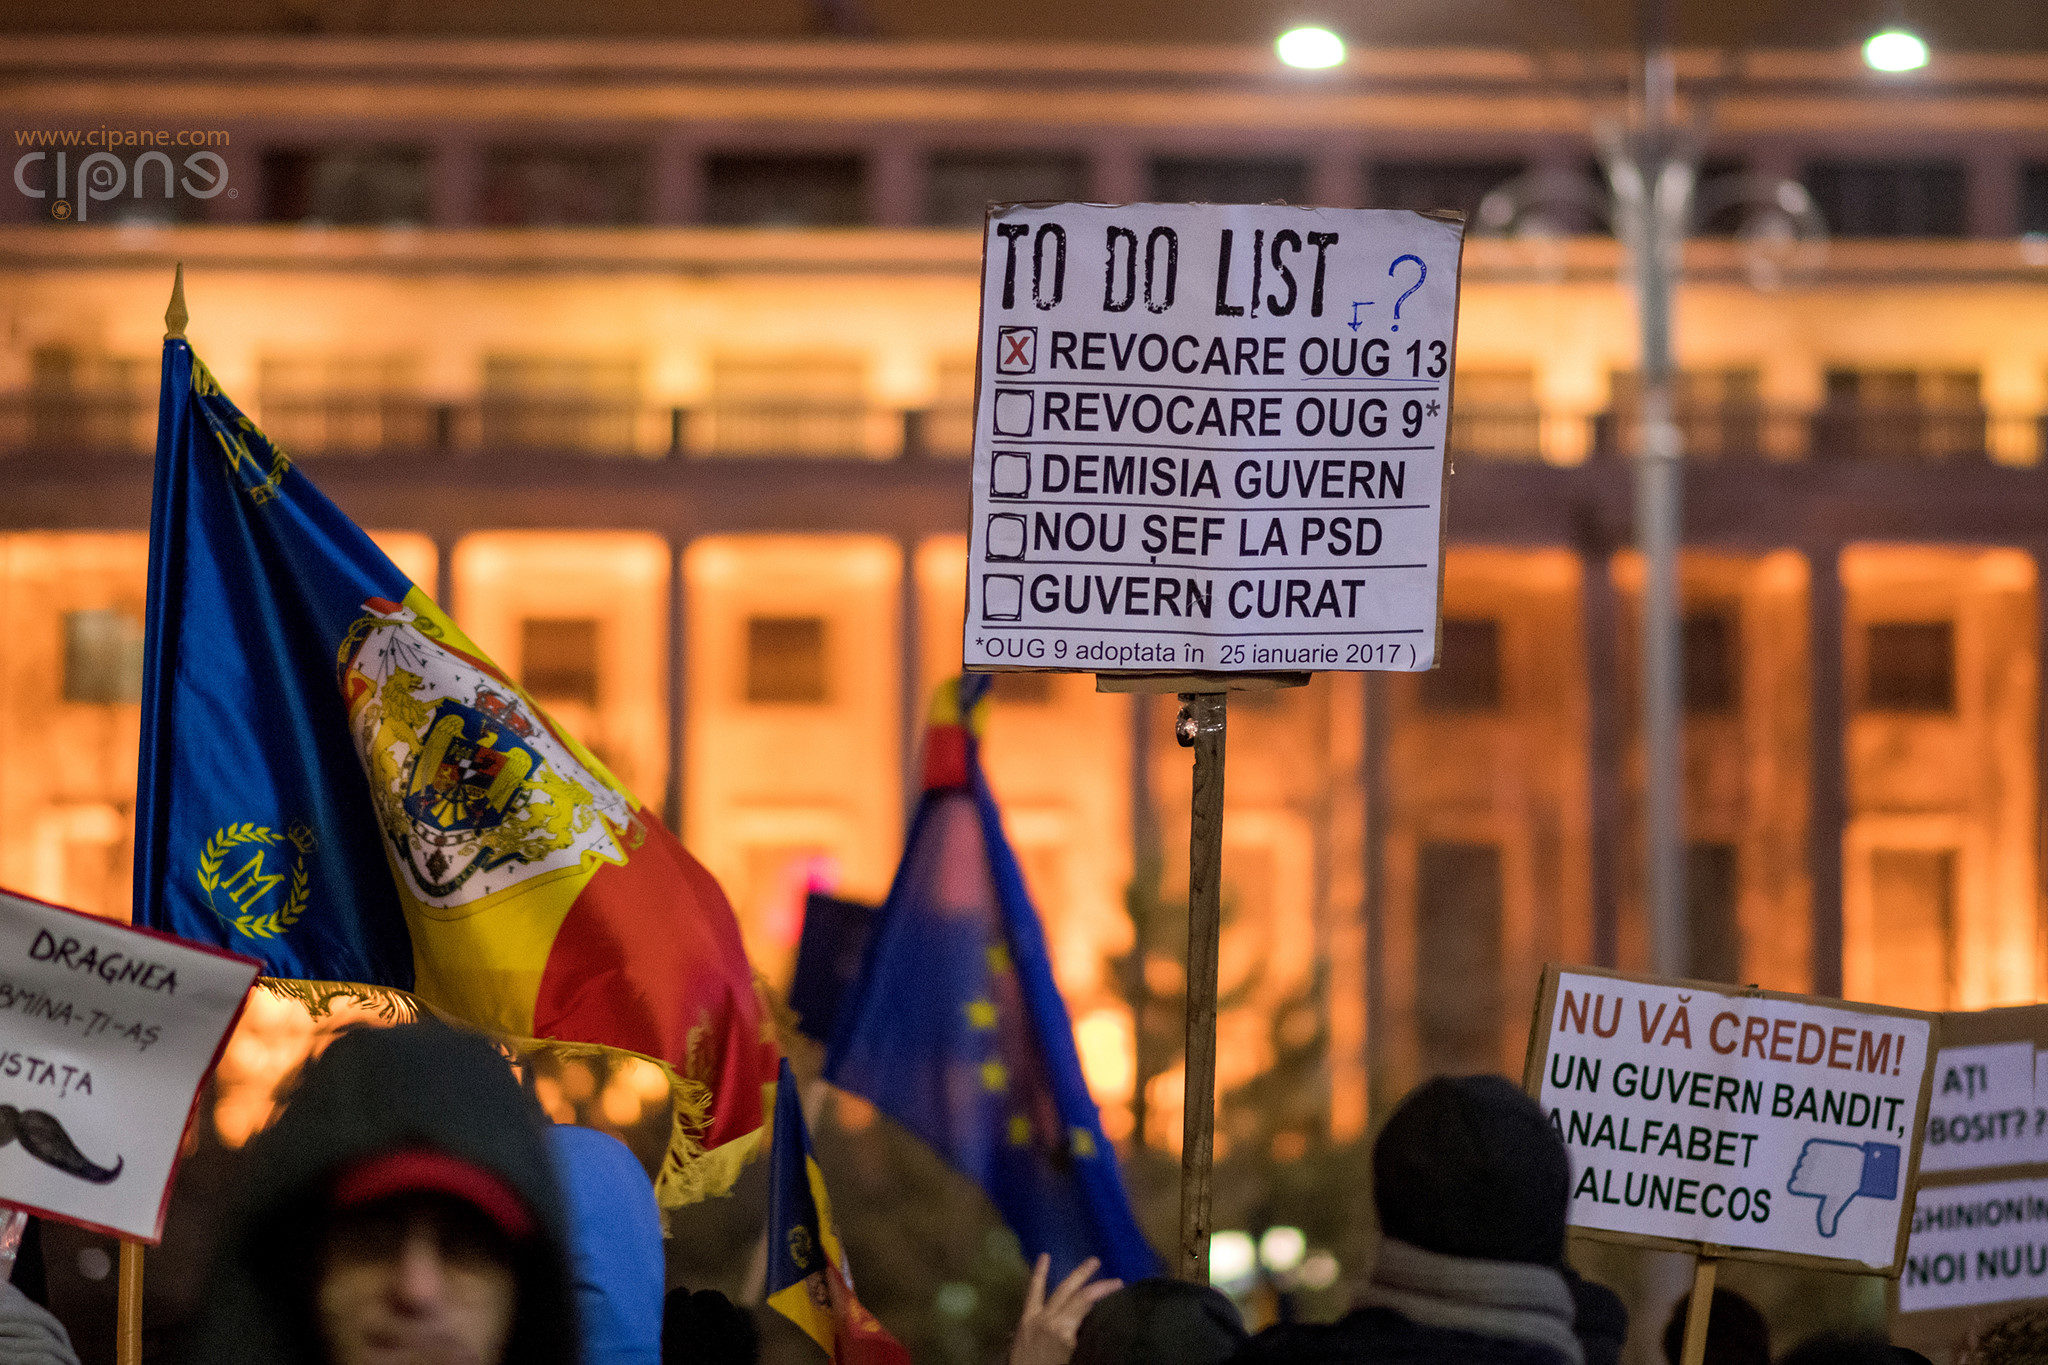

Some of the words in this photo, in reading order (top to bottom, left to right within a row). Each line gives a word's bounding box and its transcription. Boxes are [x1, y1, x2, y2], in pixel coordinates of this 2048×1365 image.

[997, 222, 1067, 314] TO
[1103, 225, 1178, 314] DO
[1215, 229, 1339, 318] LIST
[1050, 331, 1286, 376] REVOCARE
[1300, 338, 1390, 378] OUG
[1405, 340, 1448, 379] 13
[1042, 391, 1283, 438] REVOCARE
[1296, 397, 1388, 438] OUG
[1041, 453, 1222, 499] DEMISIA
[1234, 459, 1406, 499] GUVERN
[1033, 511, 1126, 553] NOU
[1141, 514, 1226, 565] ȘEF
[1239, 517, 1289, 557] LA
[1300, 517, 1383, 557] PSD
[1029, 573, 1213, 619] GUVERN
[1228, 579, 1366, 619] CURAT
[1053, 639, 1068, 660] 9
[1075, 639, 1176, 669] adoptata
[1184, 642, 1204, 663] în
[1220, 644, 1246, 665] 25
[1252, 643, 1339, 665] ianuarie
[1346, 643, 1402, 665] 2017
[28, 928, 179, 995] DRAGNEA
[1558, 989, 1624, 1039] NU
[1638, 994, 1694, 1050] VĂ
[1709, 1010, 1906, 1077] CREDEM!
[1551, 1053, 1602, 1093] UN
[1612, 1061, 1764, 1115] GUVERN
[1771, 1082, 1906, 1139] BANDIT,
[1548, 1107, 1759, 1168] ANALFABET
[1573, 1166, 1772, 1224] ALUNECOS
[1907, 1251, 1966, 1288] NOI
